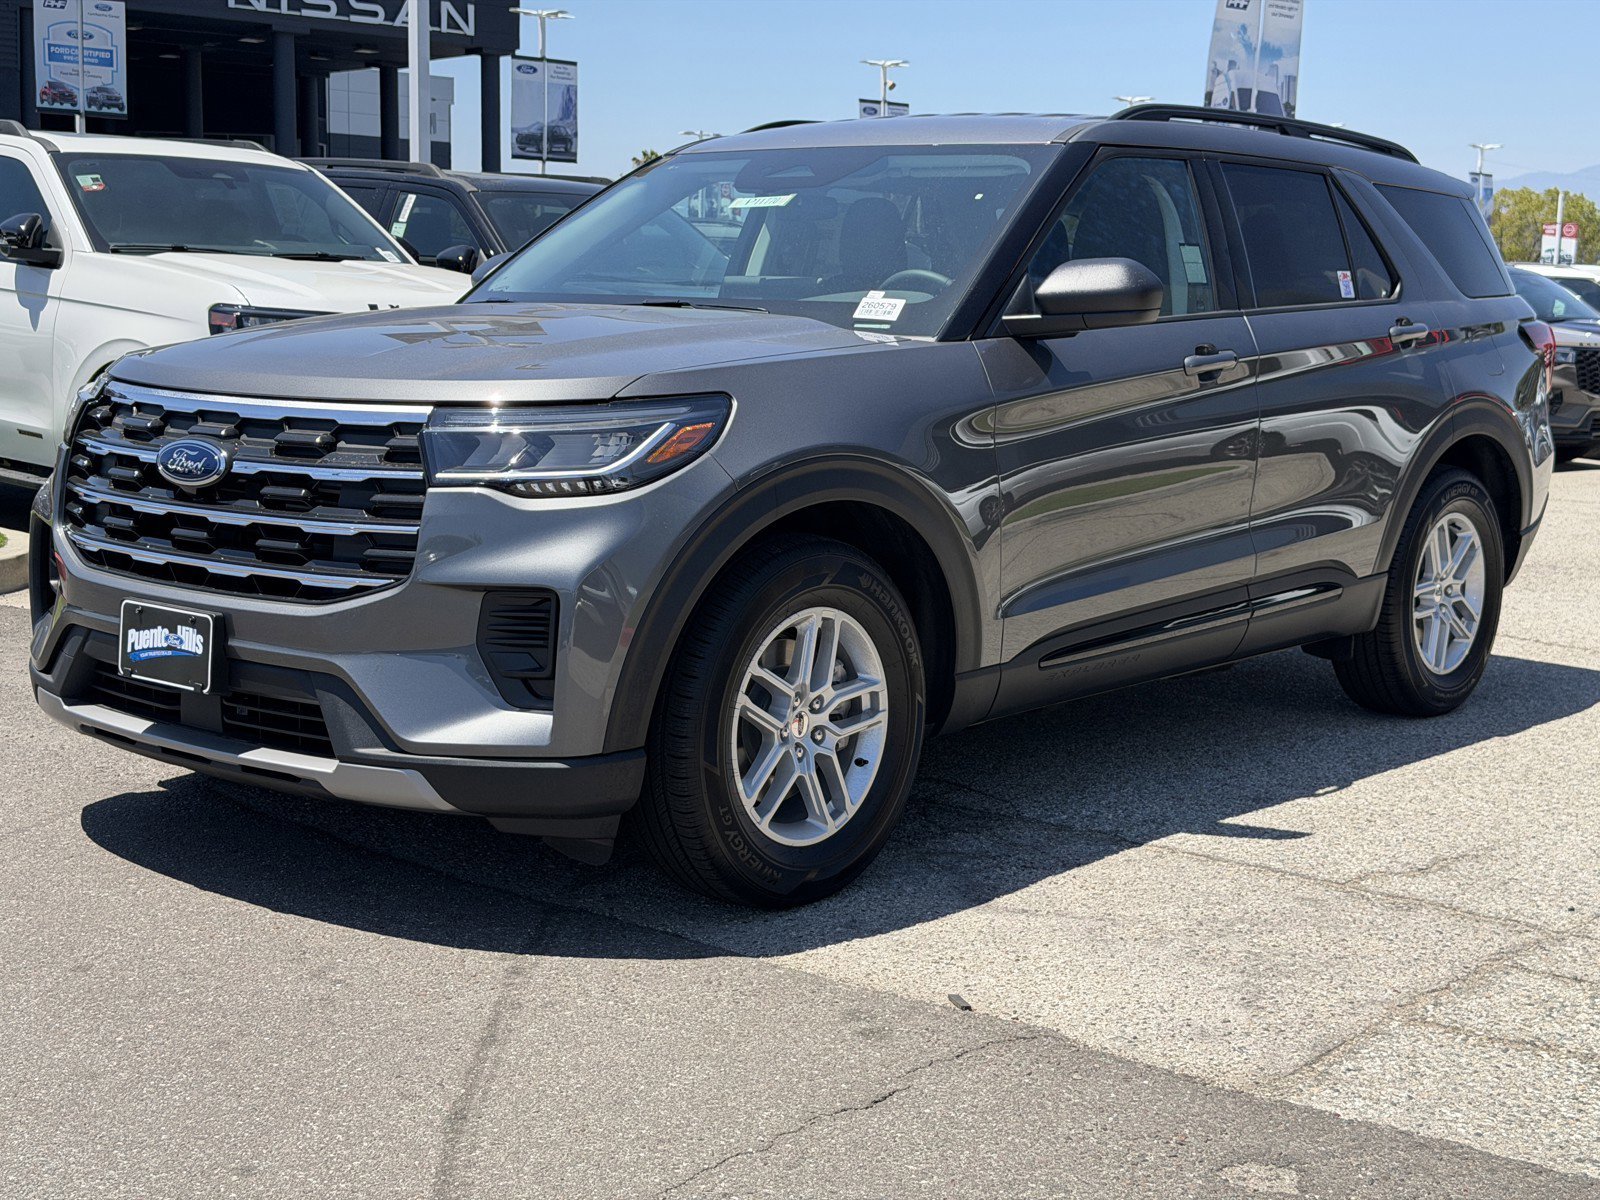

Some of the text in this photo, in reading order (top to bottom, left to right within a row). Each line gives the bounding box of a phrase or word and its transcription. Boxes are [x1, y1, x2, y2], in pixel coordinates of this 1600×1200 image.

[228, 0, 474, 36] SSN
[50, 46, 111, 58] FORD CTIFIED
[63, 55, 99, 64] PRE-ONED
[861, 301, 897, 310] 260579
[167, 447, 208, 472] Ford
[126, 625, 169, 653] Puente
[177, 624, 203, 655] Hills
